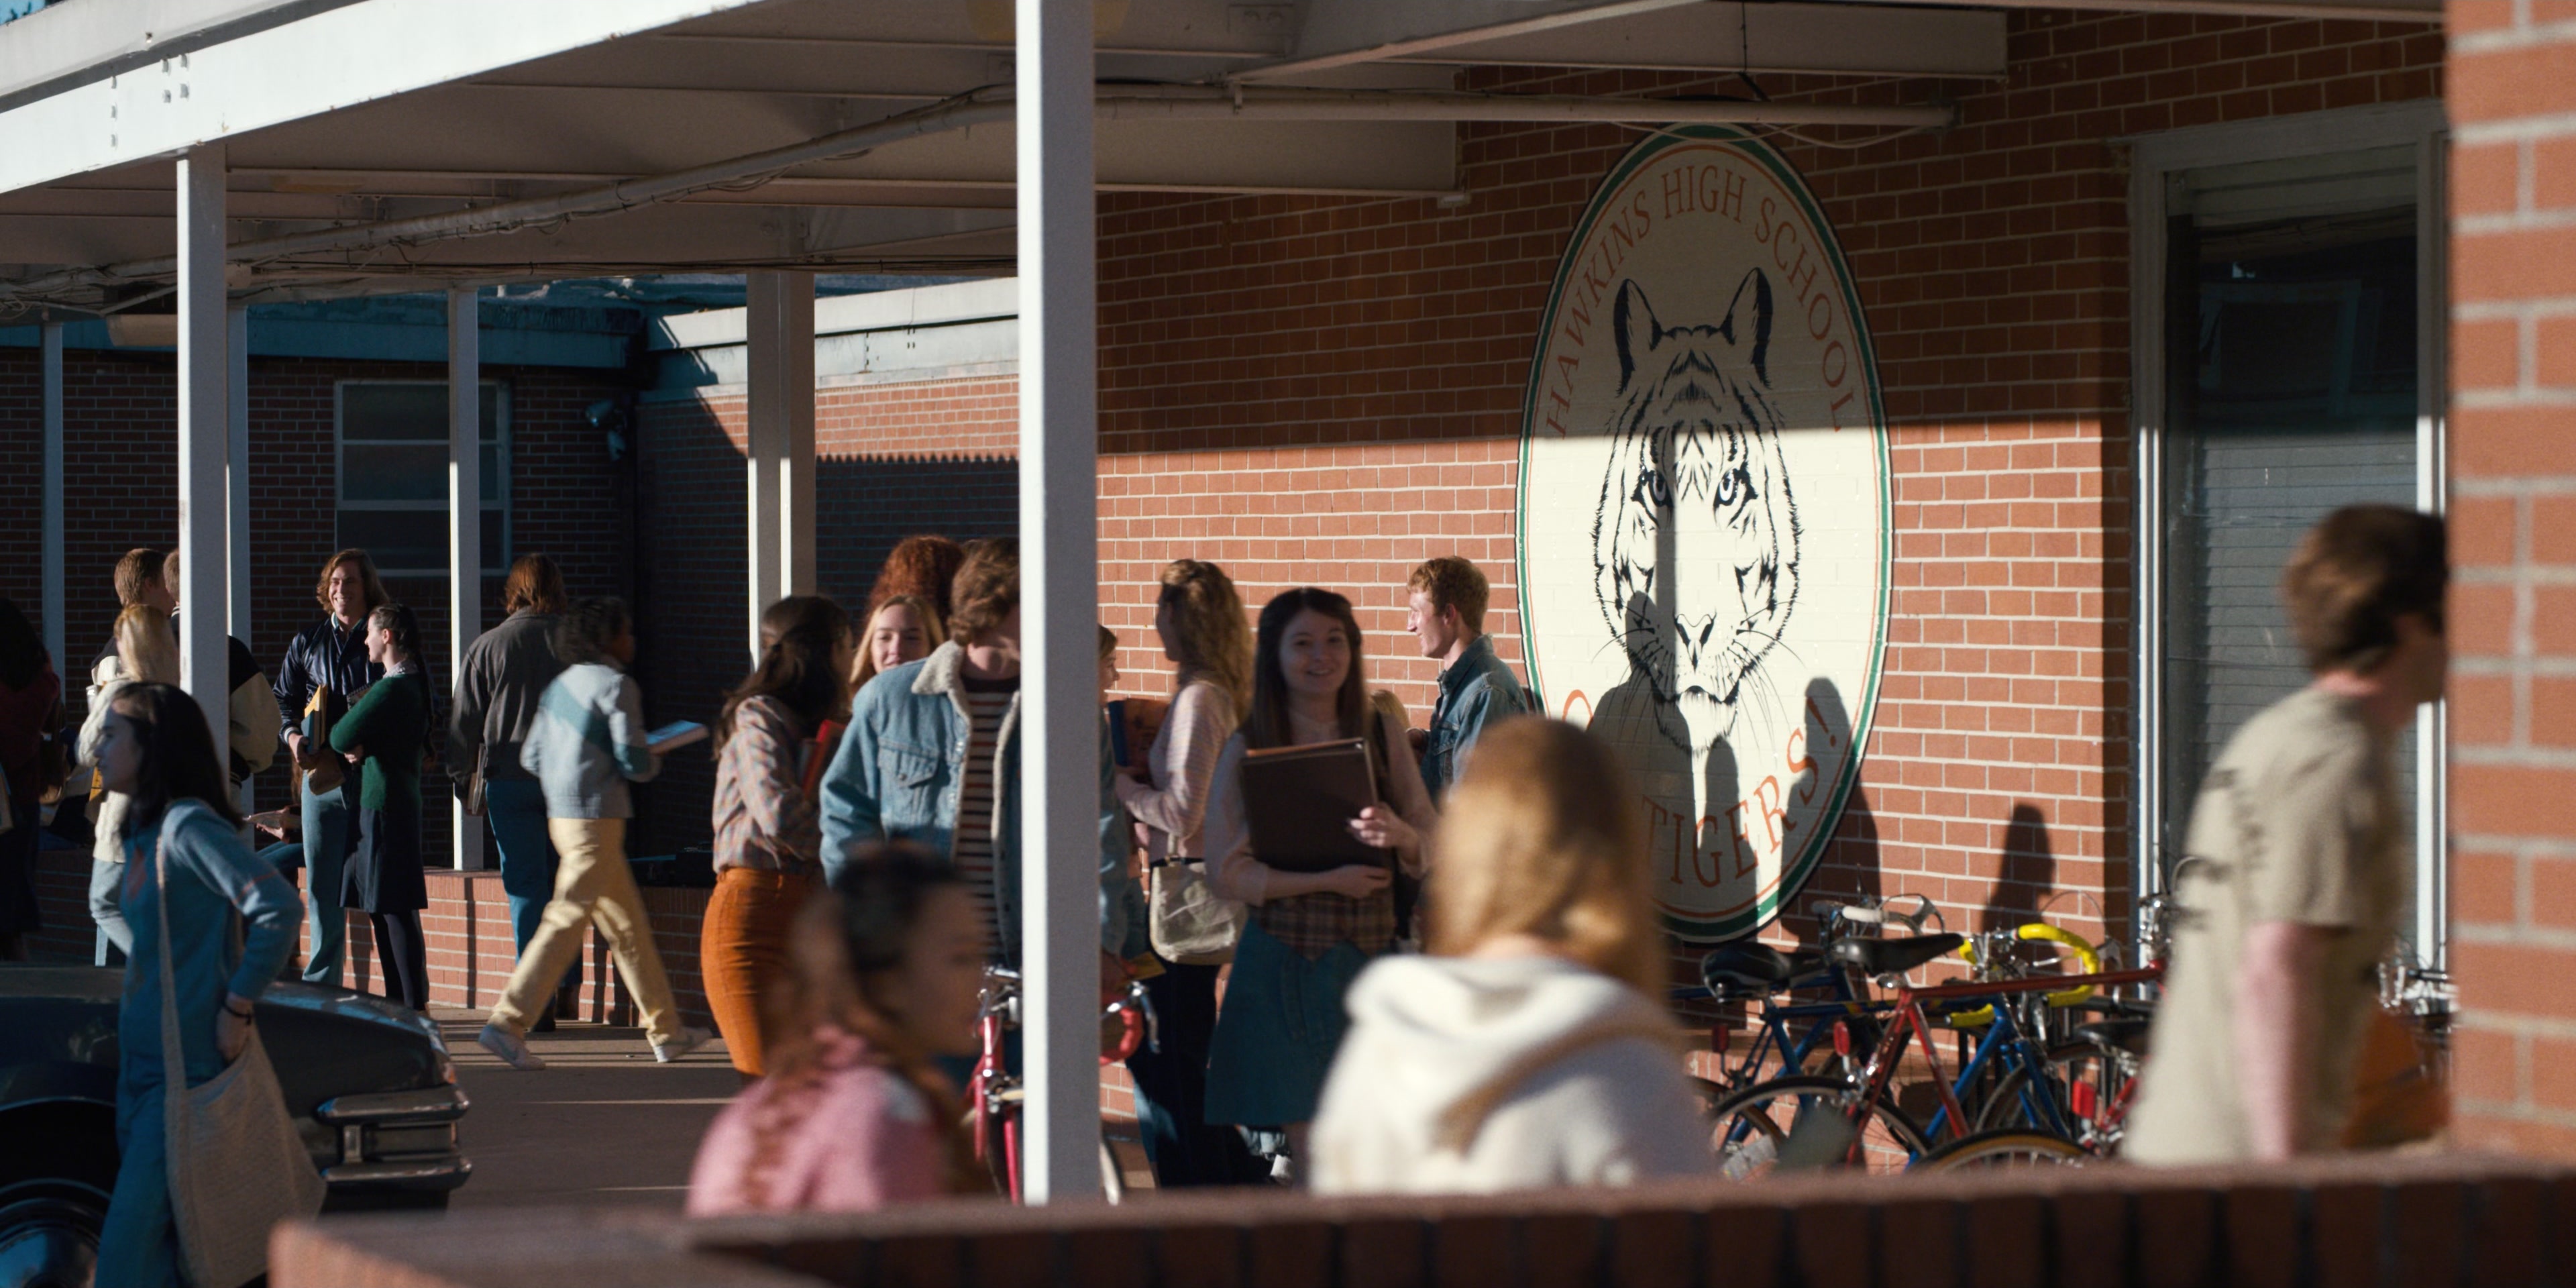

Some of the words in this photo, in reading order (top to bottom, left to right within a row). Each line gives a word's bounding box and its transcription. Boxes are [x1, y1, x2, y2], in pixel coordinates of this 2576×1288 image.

[1546, 191, 1650, 439] HAWKINS
[1661, 165, 1746, 223] HIGH
[1756, 197, 1854, 432] SCHOOL
[1642, 697, 1836, 888] TIGERS!
